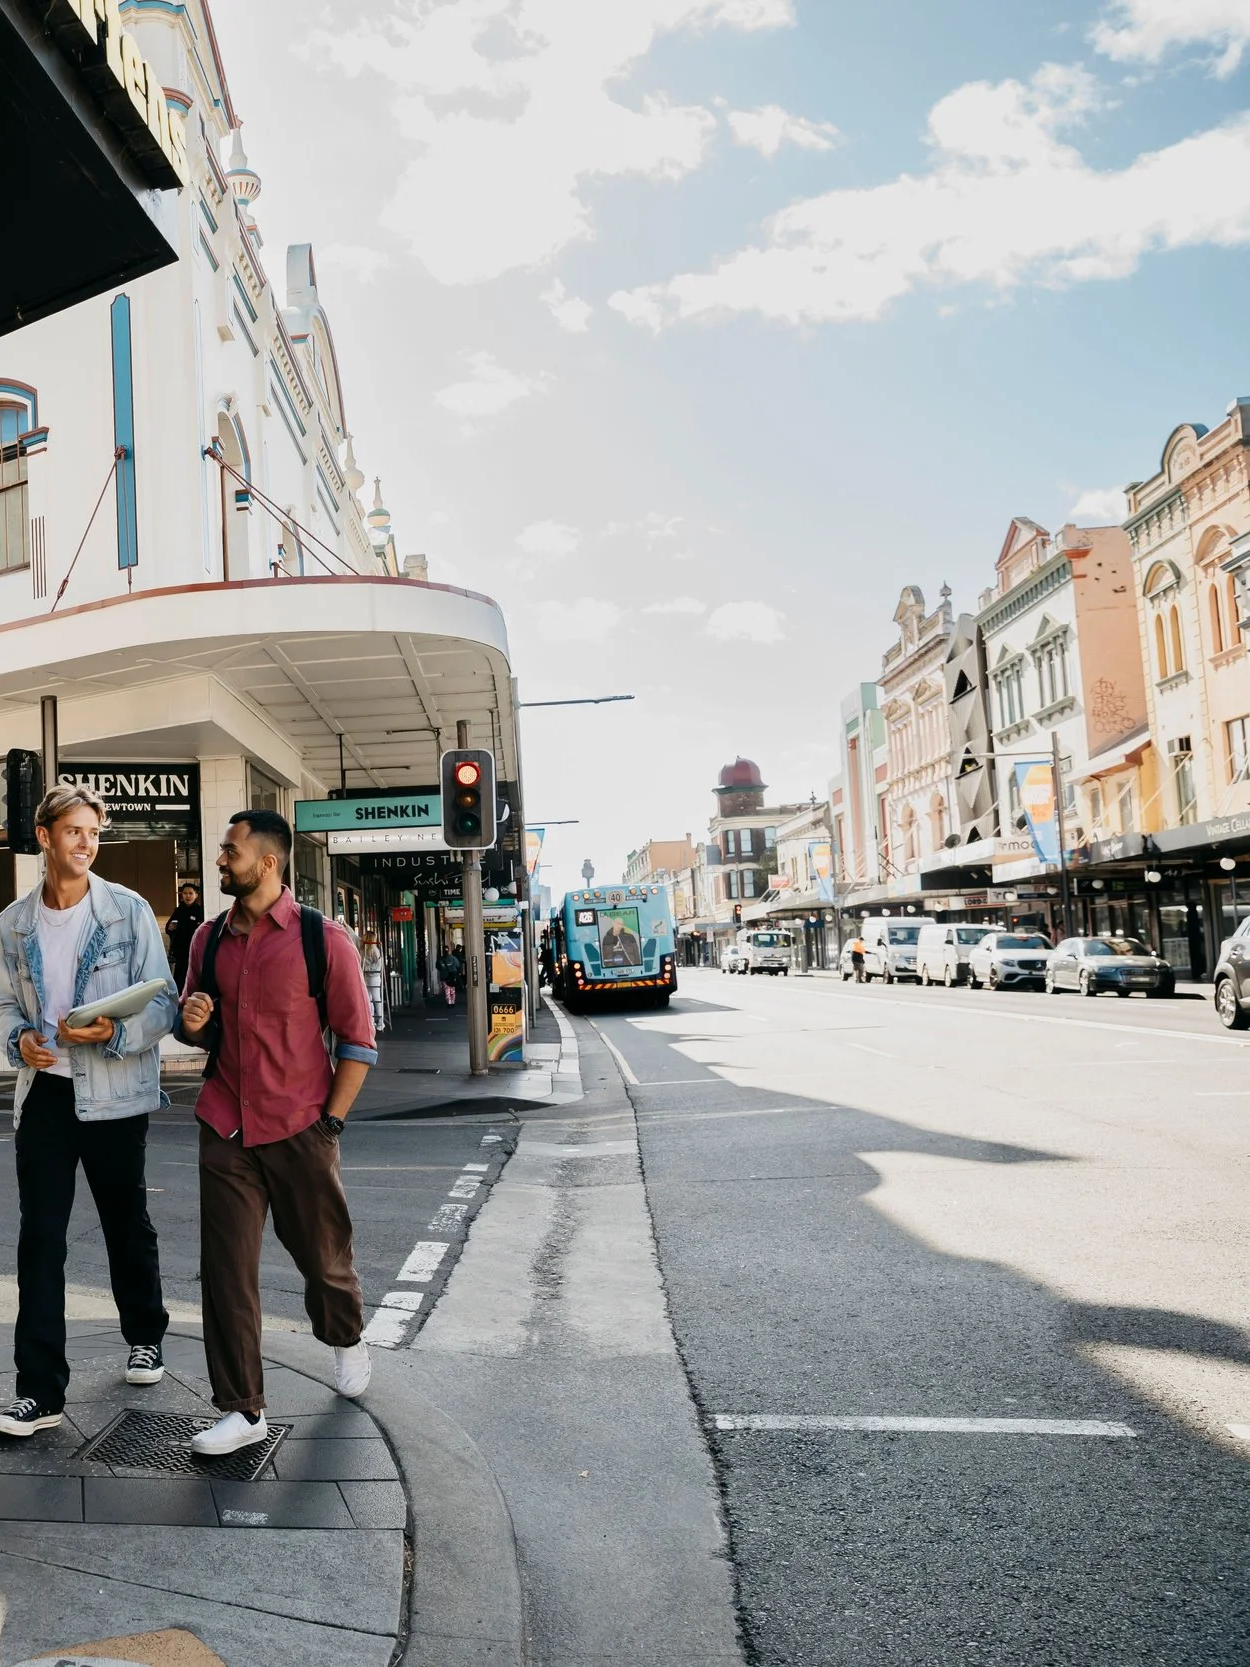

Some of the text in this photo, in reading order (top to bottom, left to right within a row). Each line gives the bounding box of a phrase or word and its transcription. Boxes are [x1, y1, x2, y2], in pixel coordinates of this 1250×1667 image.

[68, 0, 190, 187] tens
[58, 773, 190, 797] SHENKIN
[105, 803, 152, 811] EWTOWN
[355, 803, 430, 820] SHENKIN
[332, 832, 405, 844] BAILEY
[413, 872, 450, 887] Sushi
[443, 888, 461, 896] TIME
[611, 893, 621, 902] 40
[493, 1005, 514, 1014] 0666
